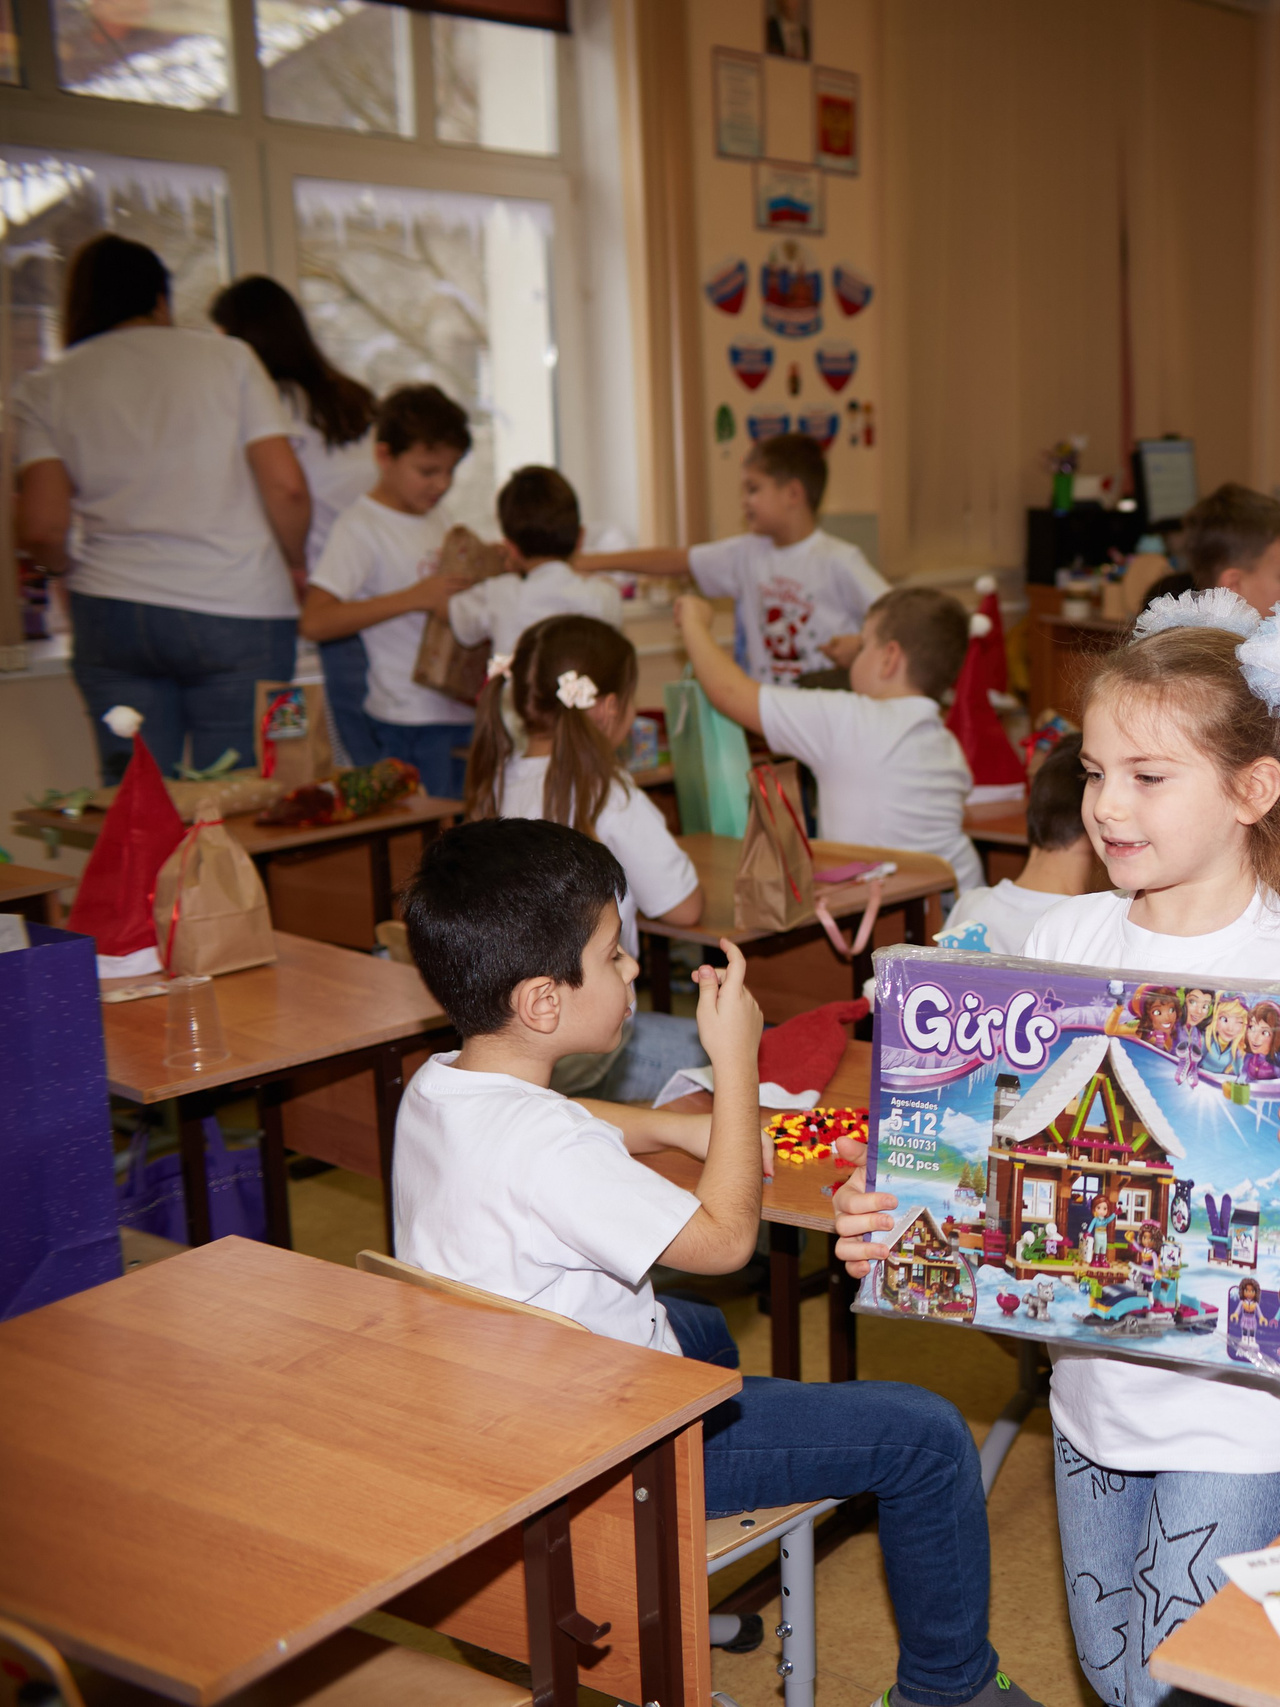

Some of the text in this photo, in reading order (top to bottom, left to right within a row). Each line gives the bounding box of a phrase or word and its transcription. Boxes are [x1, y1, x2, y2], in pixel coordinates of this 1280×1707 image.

[901, 982, 1058, 1069] Girls
[889, 1107, 938, 1136] 5-12
[888, 1134, 937, 1152] NO.10731
[887, 1151, 941, 1172] 402 pcs
[1090, 1469, 1127, 1500] NO
